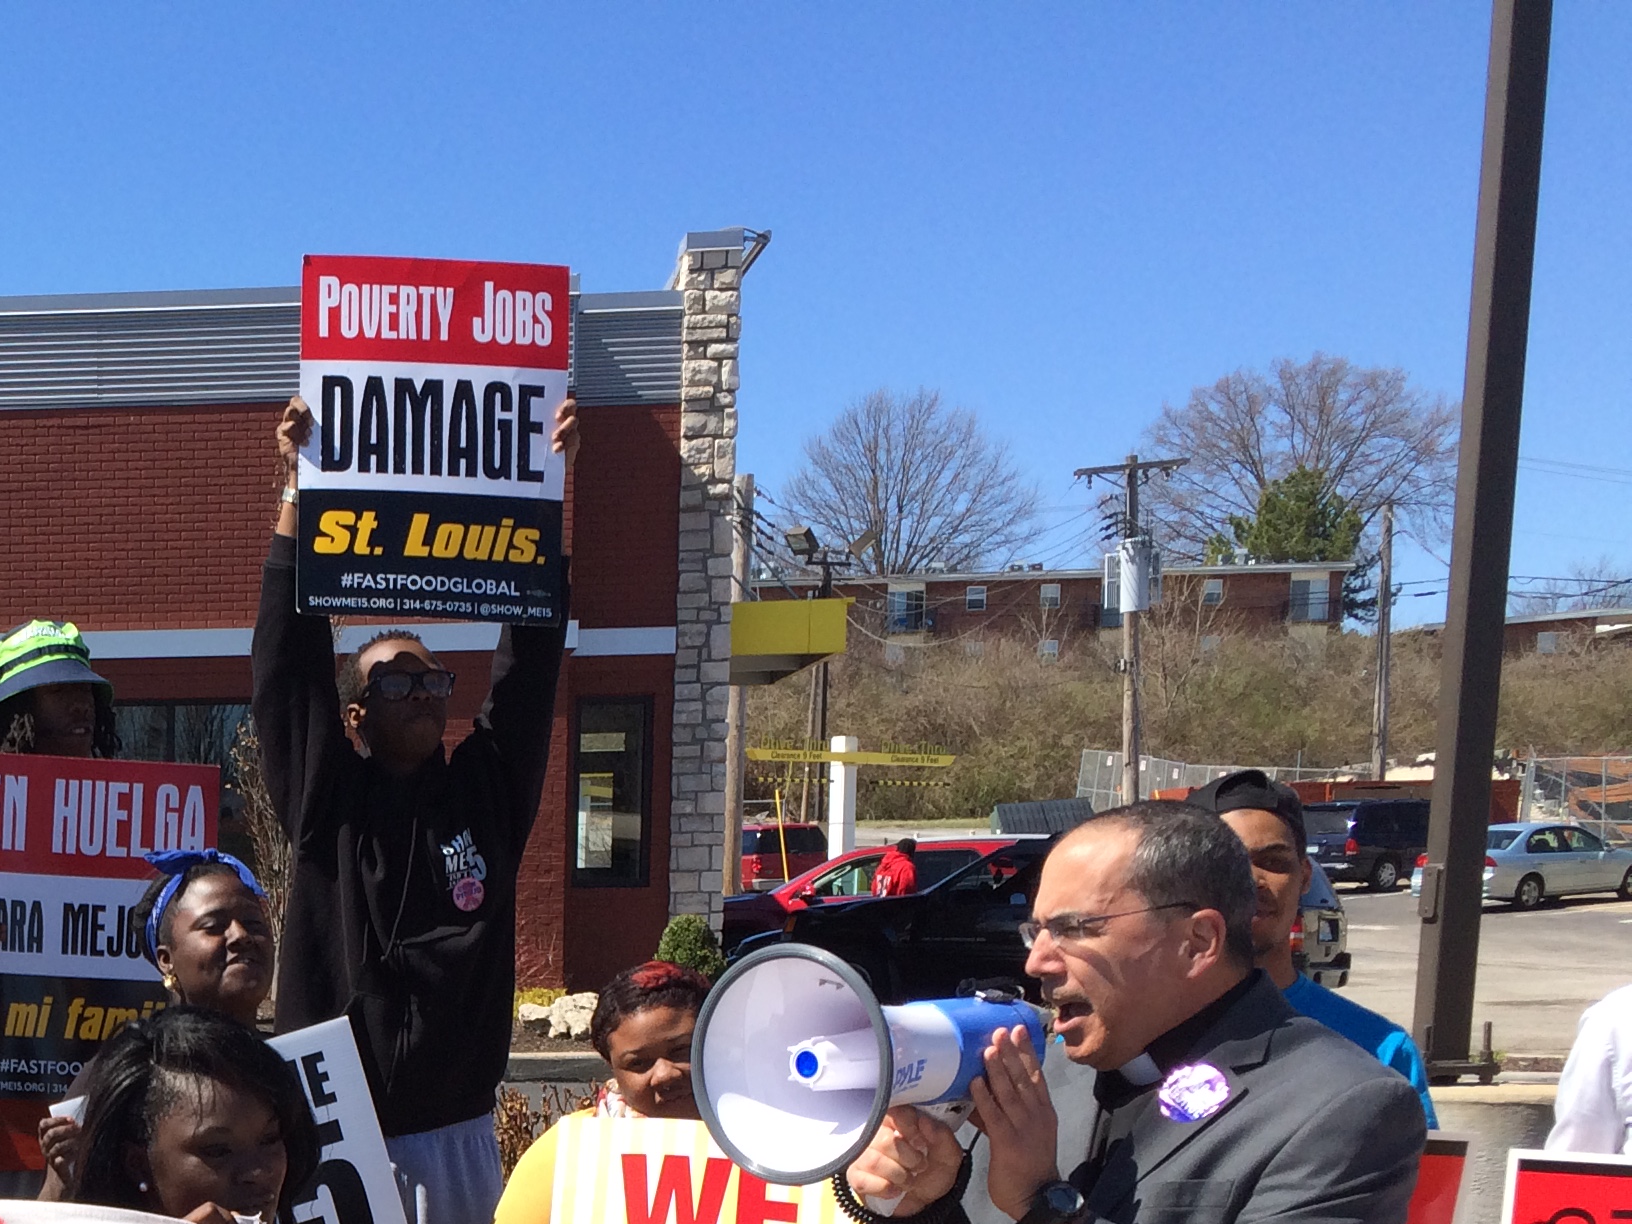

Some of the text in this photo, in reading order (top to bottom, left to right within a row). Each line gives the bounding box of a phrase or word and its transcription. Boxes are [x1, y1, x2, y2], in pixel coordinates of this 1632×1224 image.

[318, 275, 553, 347] POVERTY JOBS
[320, 375, 546, 484] DAMAGE
[313, 509, 547, 565] St. Louis.
[307, 595, 553, 619] SHOWME15.ORG 314-675-0735 @SHOW_ME15
[340, 572, 521, 597] #FASTFOODGLOBAL
[51, 778, 207, 860] HUELGA
[4, 996, 54, 1040] mi
